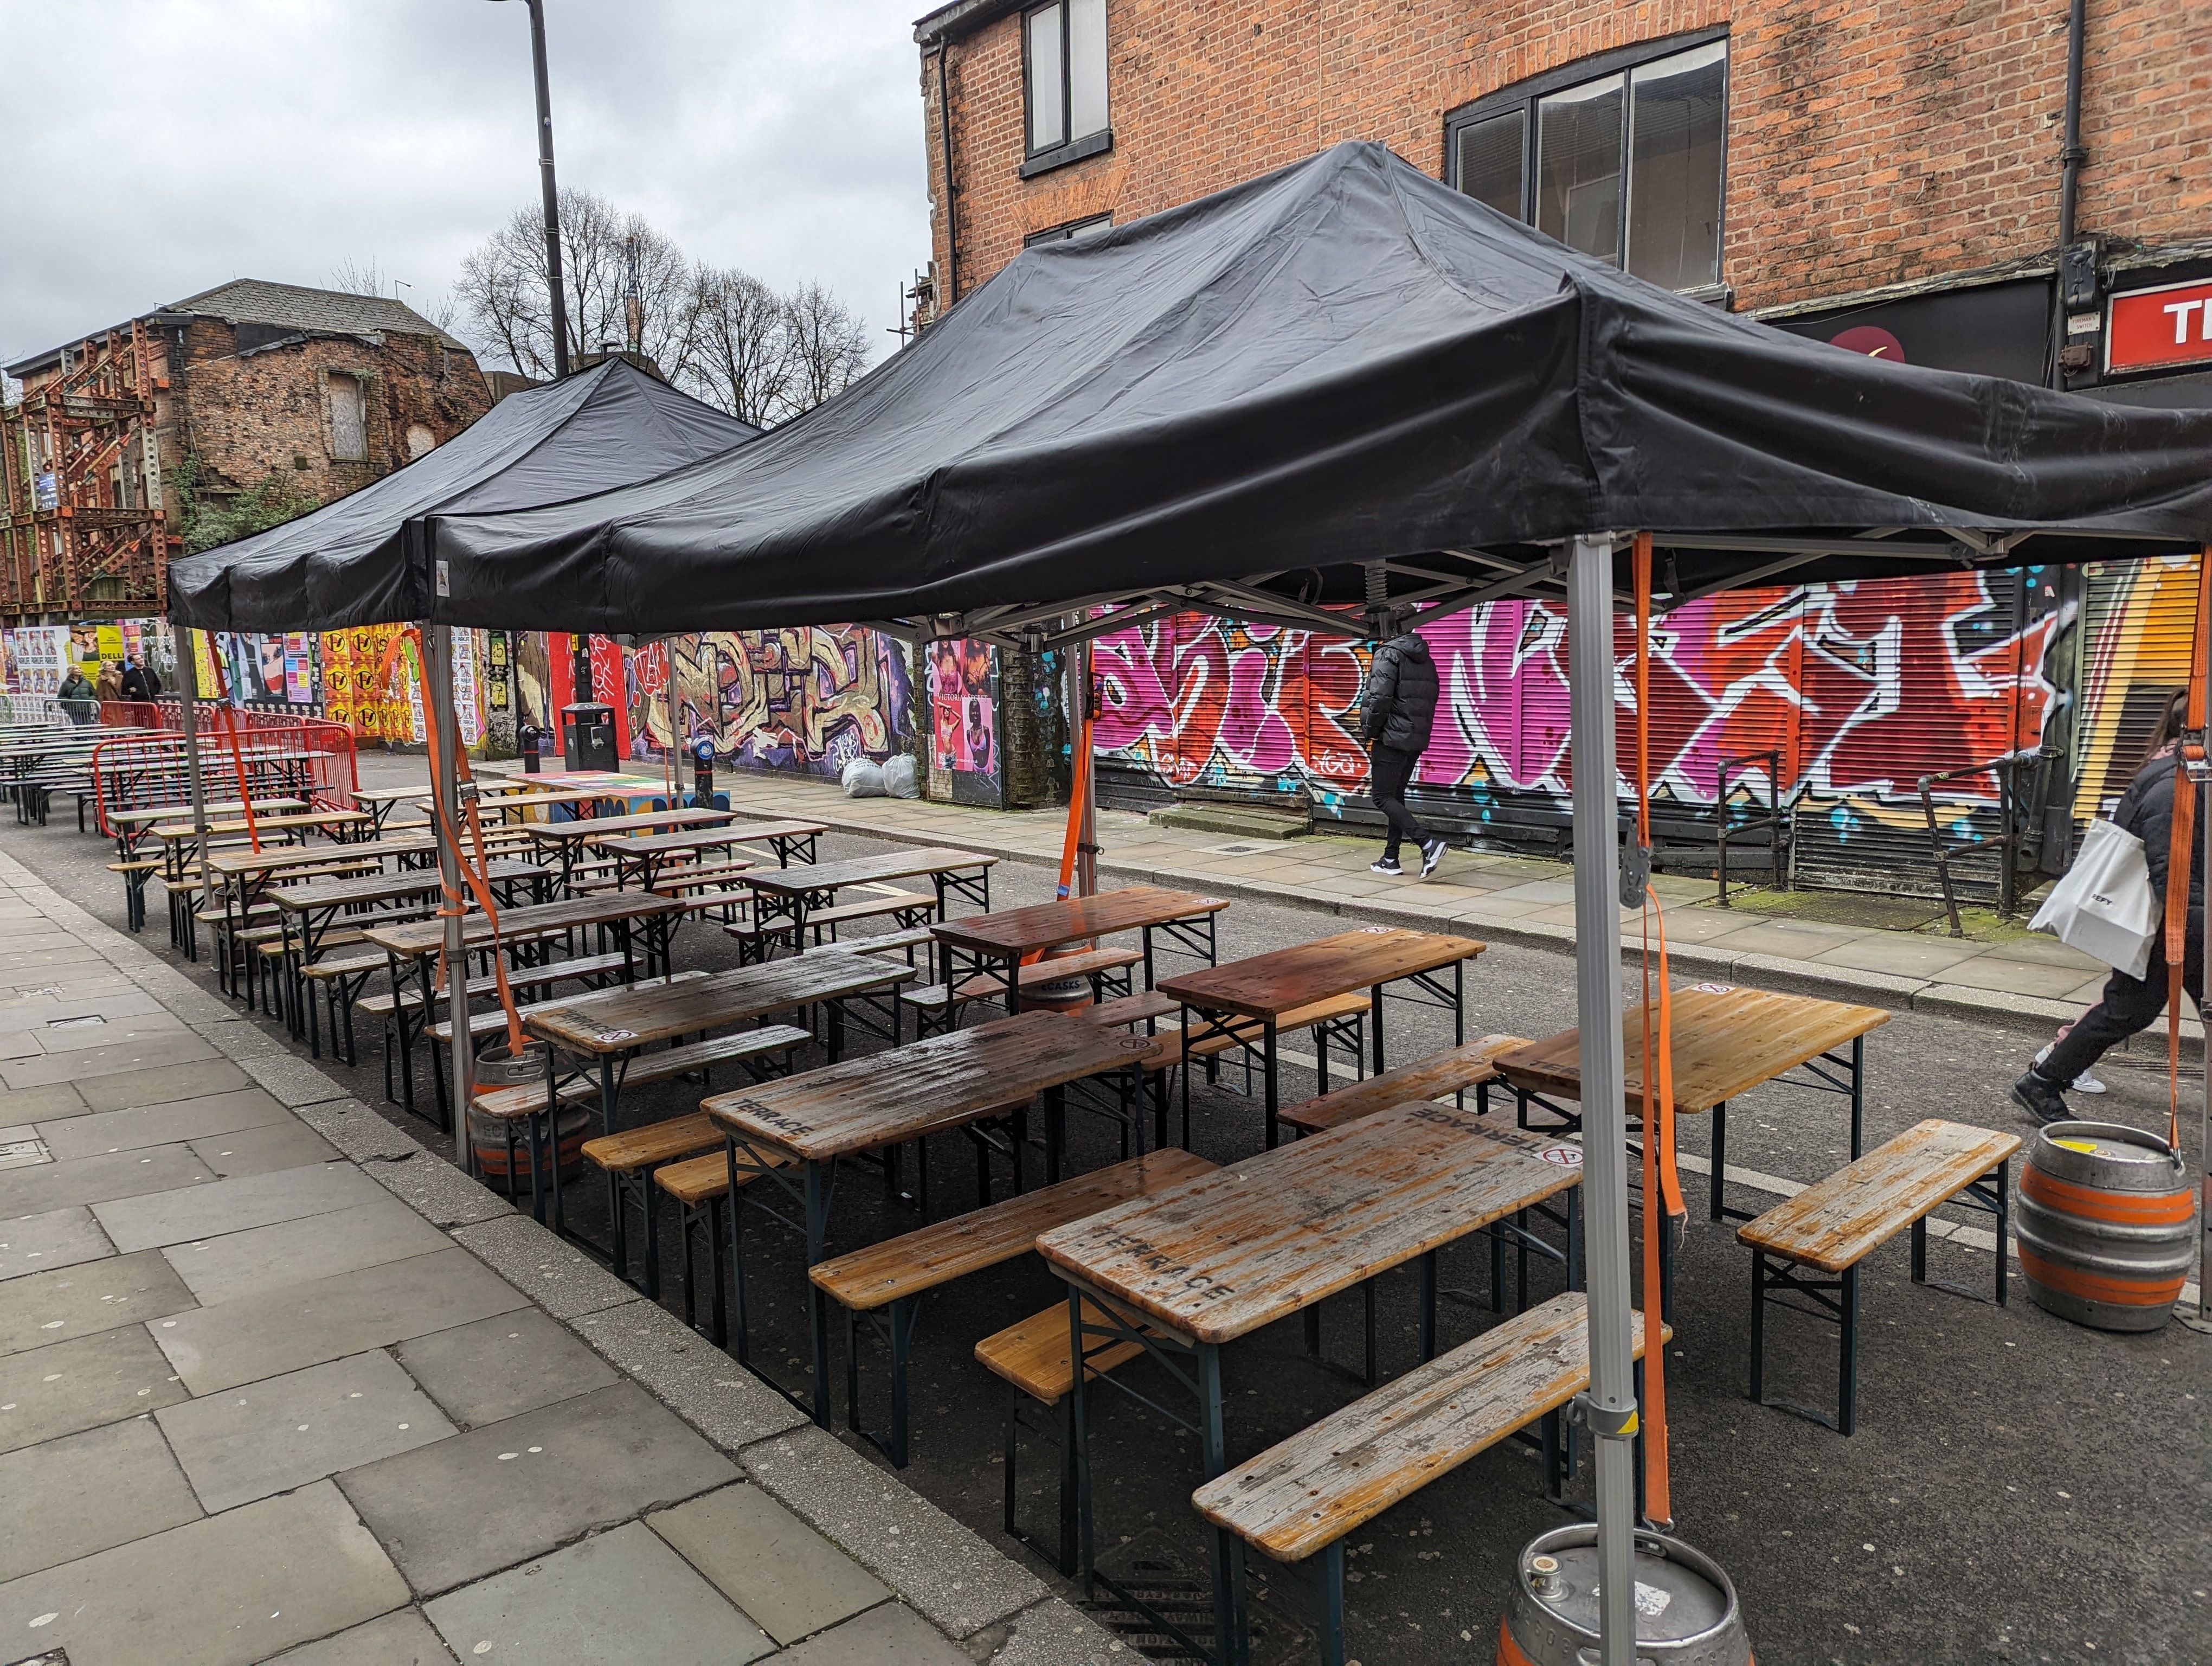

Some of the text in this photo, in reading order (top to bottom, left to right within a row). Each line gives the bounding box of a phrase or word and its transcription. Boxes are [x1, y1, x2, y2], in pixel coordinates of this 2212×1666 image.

[937, 693, 988, 702] VICTORIA'S SECRET
[1529, 1060, 1660, 1094] TERCE
[730, 1098, 815, 1136] TERRACE
[1410, 1108, 1542, 1156] TERRACE
[1092, 1227, 1235, 1300] TERRACE
